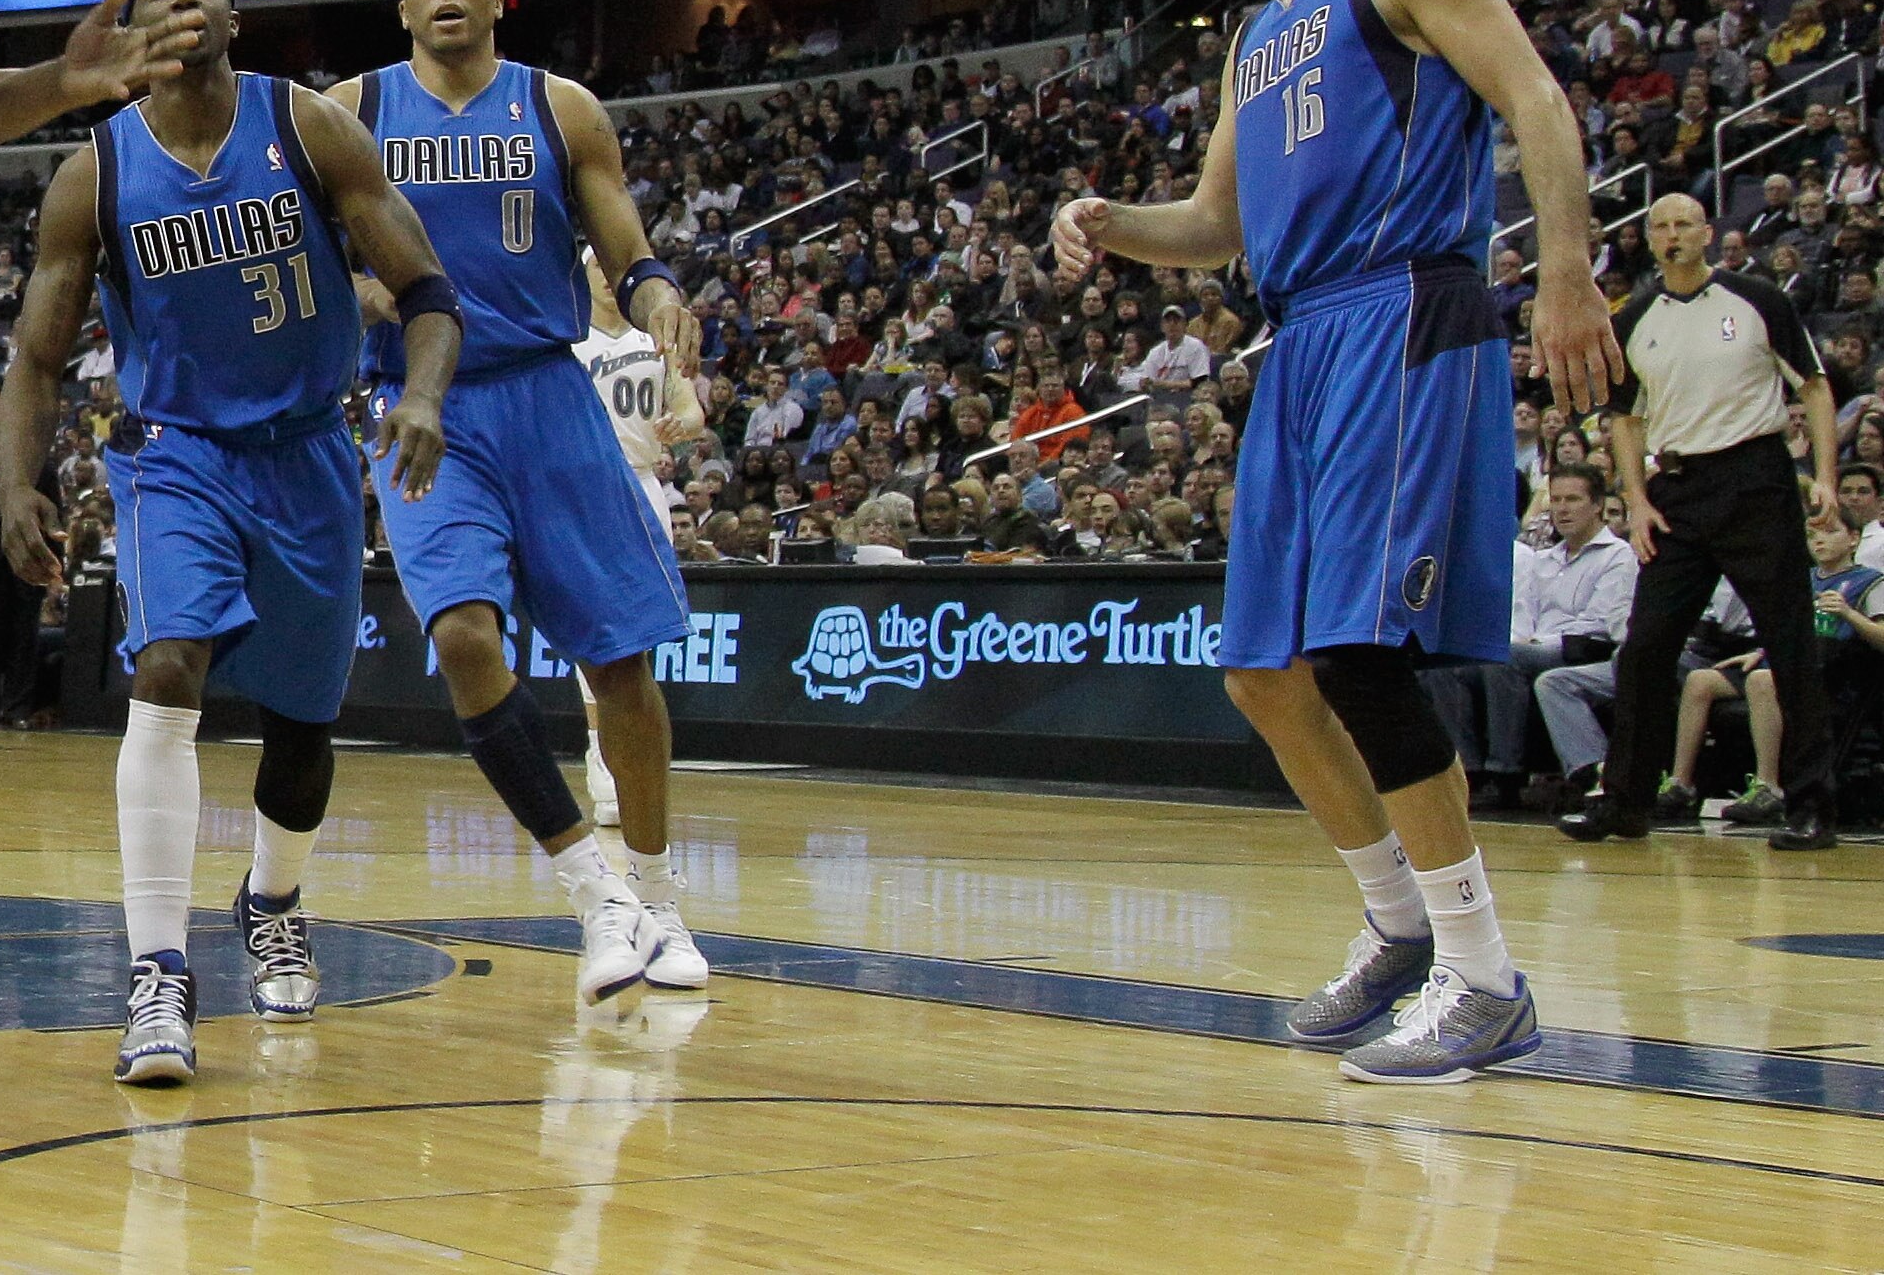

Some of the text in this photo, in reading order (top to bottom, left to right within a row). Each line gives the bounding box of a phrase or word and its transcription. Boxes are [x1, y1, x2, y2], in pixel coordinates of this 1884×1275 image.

[1236, 5, 1330, 114] DALLAS
[1282, 67, 1325, 156] 16
[384, 134, 536, 185] DALLAS
[130, 189, 304, 279] DALLAS
[502, 190, 534, 254] 0
[241, 252, 317, 334] 31
[613, 376, 655, 421] 00
[879, 597, 1222, 680] the Greene Turtle
